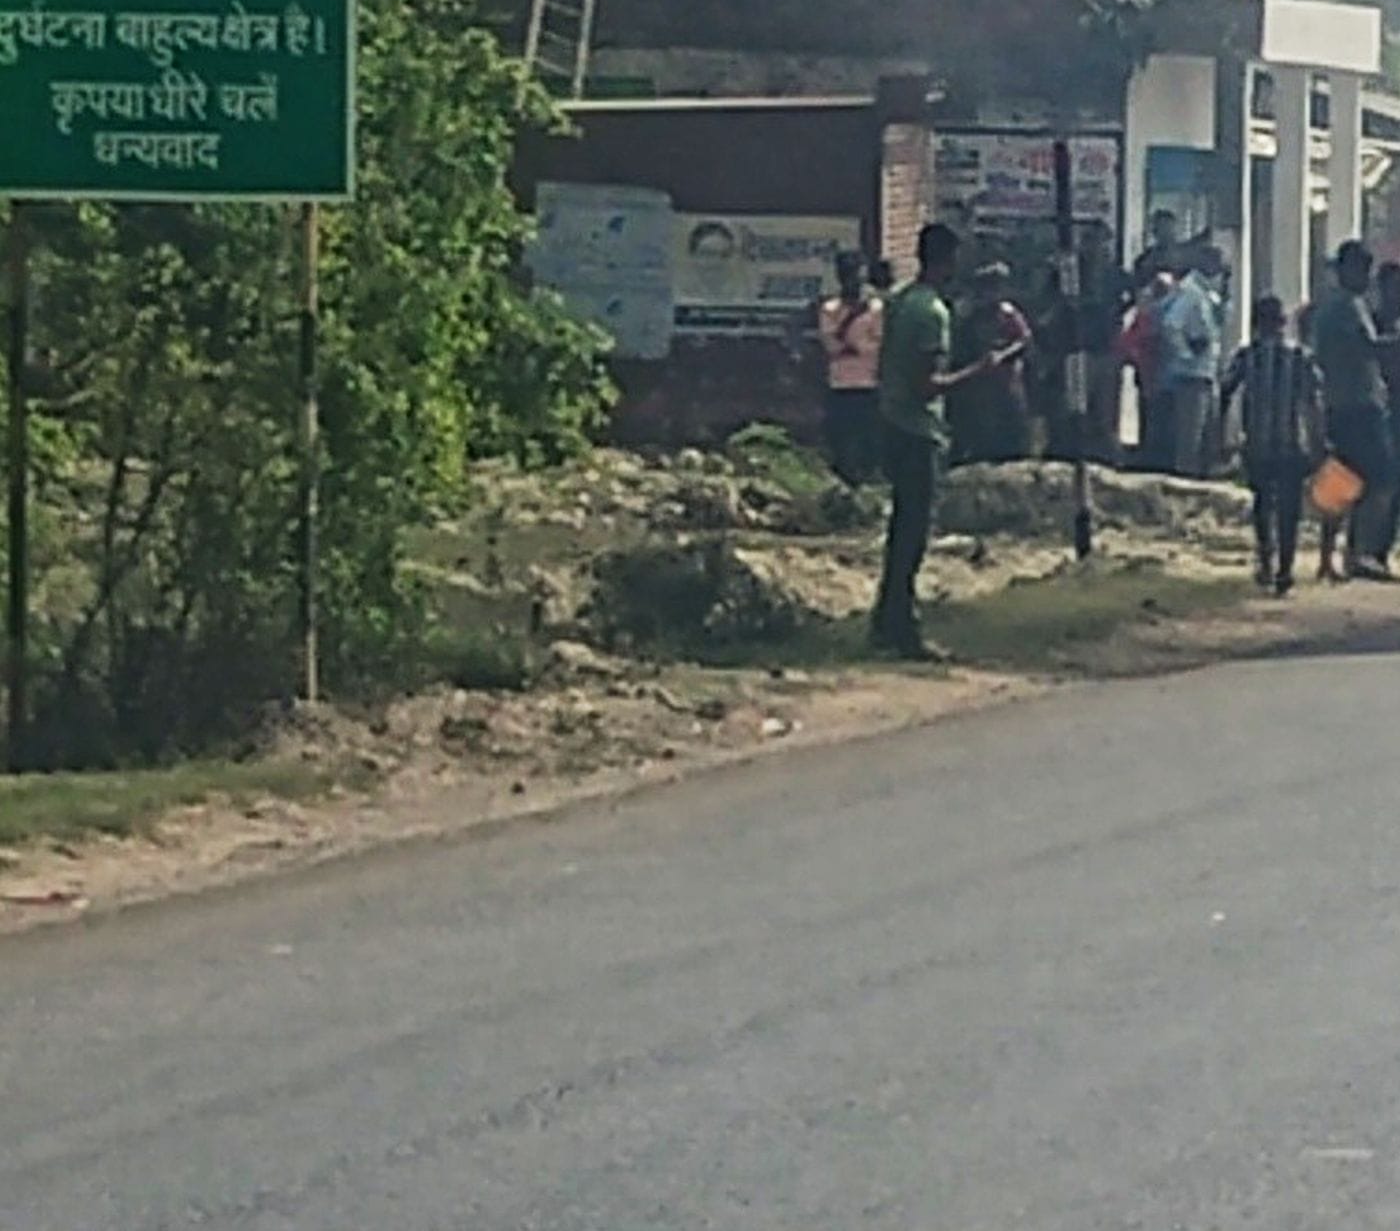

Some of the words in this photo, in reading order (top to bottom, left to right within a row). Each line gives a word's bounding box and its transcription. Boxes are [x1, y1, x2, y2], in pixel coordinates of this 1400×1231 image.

[220, 0, 279, 50] क्षेत्र
[50, 82, 144, 135] कृपया
[147, 68, 207, 120] धीरे
[220, 72, 278, 120] चलें
[93, 131, 222, 169] धन्यवाद
